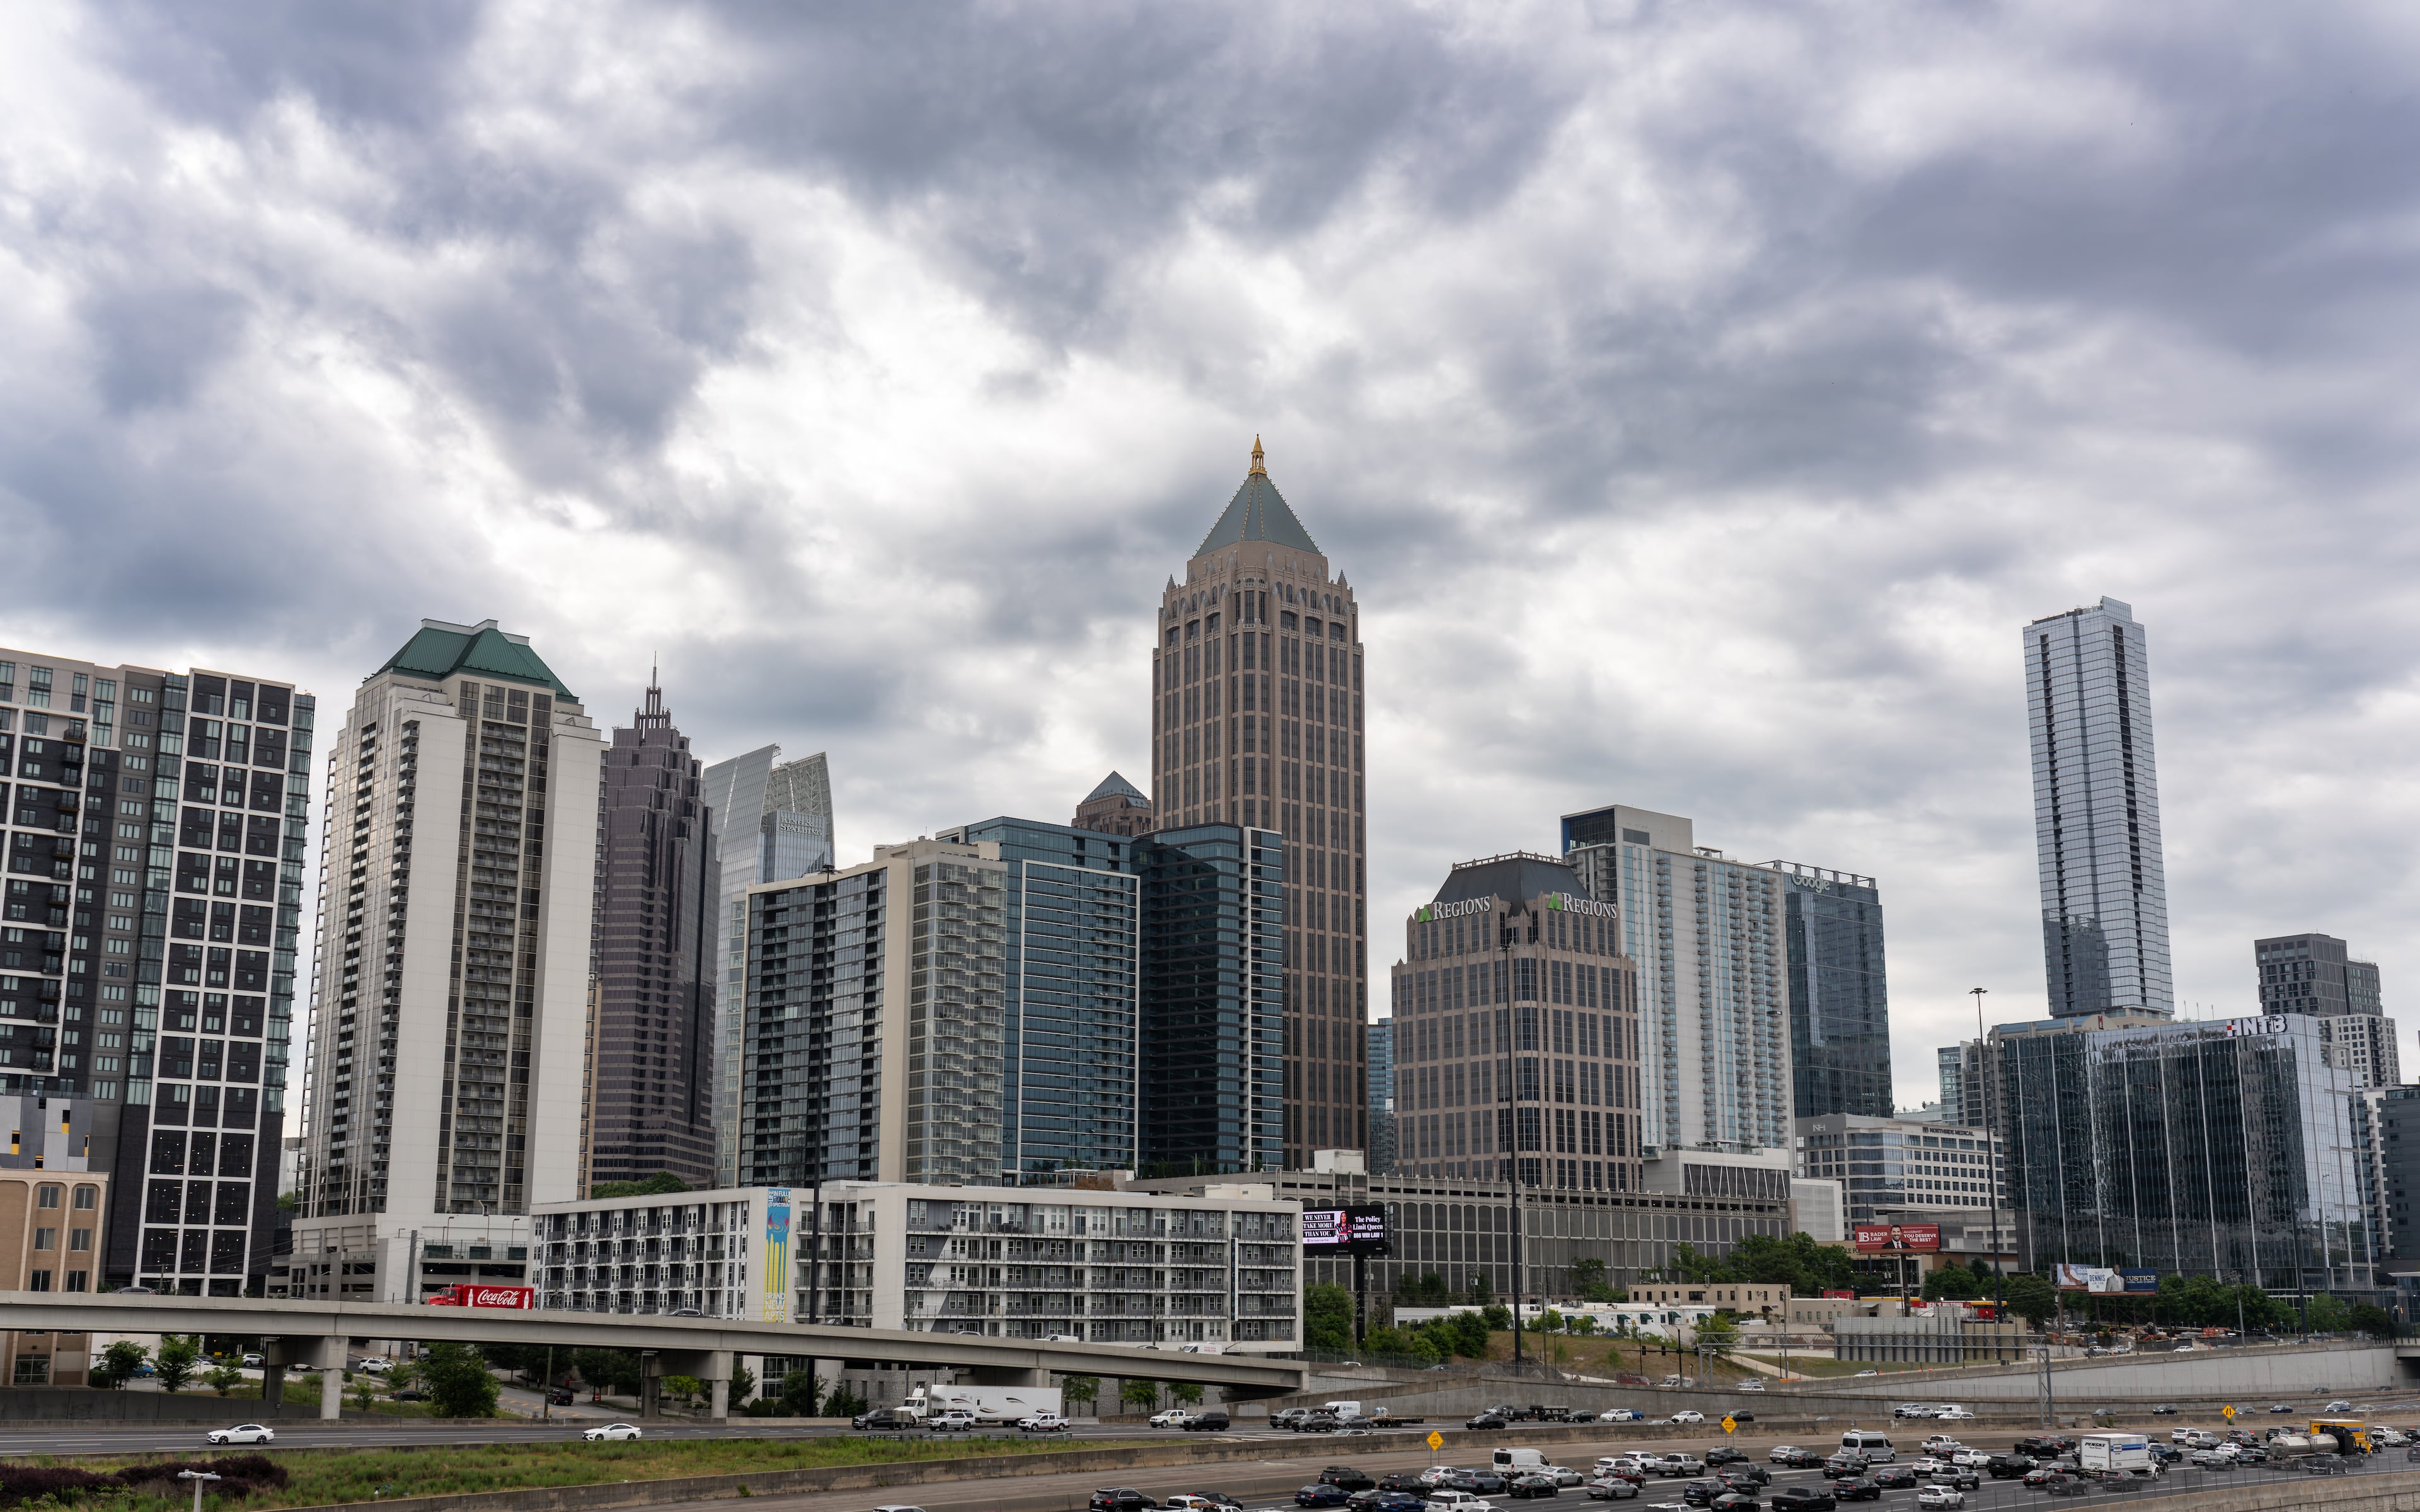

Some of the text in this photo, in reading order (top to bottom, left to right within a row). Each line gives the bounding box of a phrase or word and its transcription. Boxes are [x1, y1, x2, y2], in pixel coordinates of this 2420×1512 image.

[781, 816, 802, 825] KING
[781, 823, 822, 836] SPALDING
[1792, 869, 1830, 893] Google
[1433, 896, 1490, 920] REGIONS
[1562, 892, 1617, 919] REGIONS
[2227, 1015, 2287, 1037] HNTB
[765, 1300, 785, 1310] NEW
[764, 1311, 784, 1321] APTS
